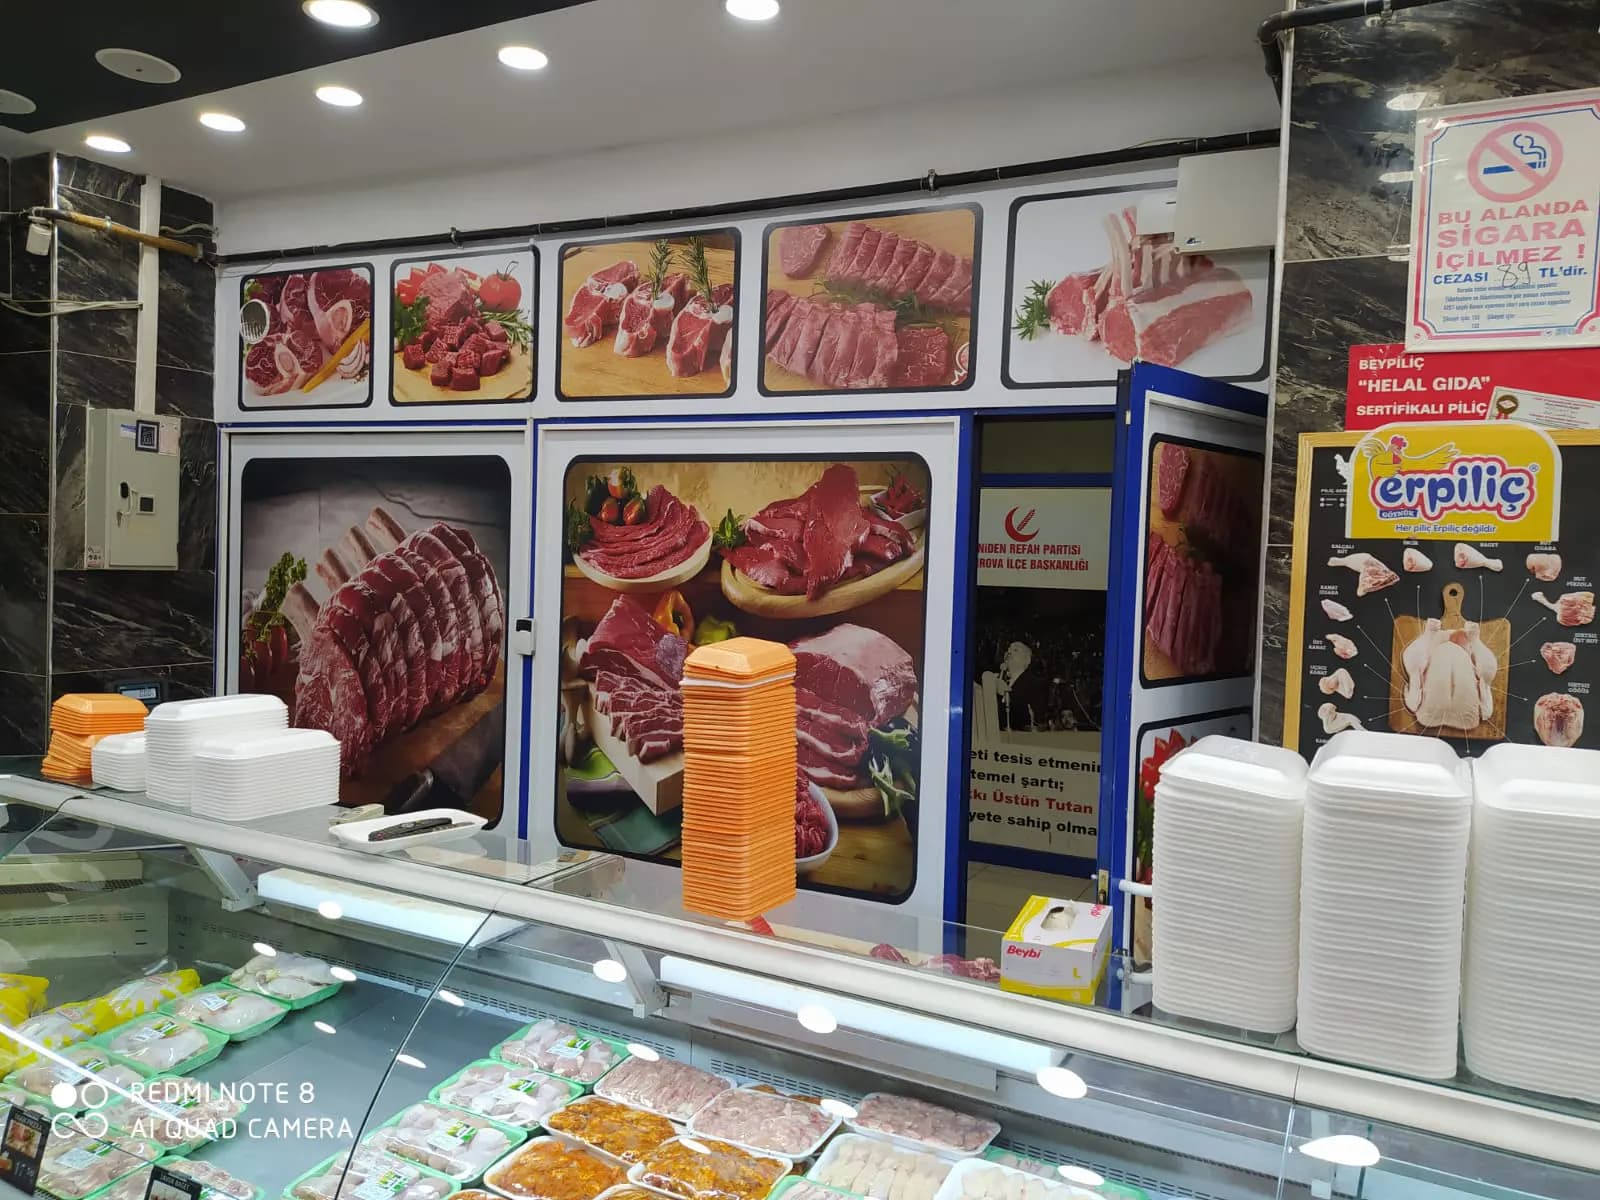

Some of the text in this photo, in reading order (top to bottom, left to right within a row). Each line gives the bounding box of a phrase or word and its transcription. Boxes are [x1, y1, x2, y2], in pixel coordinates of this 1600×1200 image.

[1438, 199, 1590, 225] BU ALANDA
[1437, 218, 1586, 248] SİGARA
[1436, 244, 1585, 273] İÇİLMEZ !
[1433, 271, 1489, 285] CEZASI
[1539, 265, 1588, 278] TL'dir.
[1359, 354, 1425, 371] BEYPİLİÇ
[1356, 402, 1488, 417] SERTİFİKALI PİLİÇ
[1379, 465, 1526, 512] erpiliç
[1414, 524, 1431, 533] piliç
[1433, 524, 1460, 533] Erpiliç
[1461, 524, 1496, 534] değildir
[1009, 544, 1040, 555] REFAH
[994, 752, 1033, 766] tesis
[970, 770, 1064, 792] temel şartı;
[993, 790, 1040, 808] Üstün
[1046, 798, 1093, 815] Tutan
[969, 811, 1097, 836] yete sahip olma
[1006, 945, 1042, 960] Beybi
[1073, 967, 1082, 980] L
